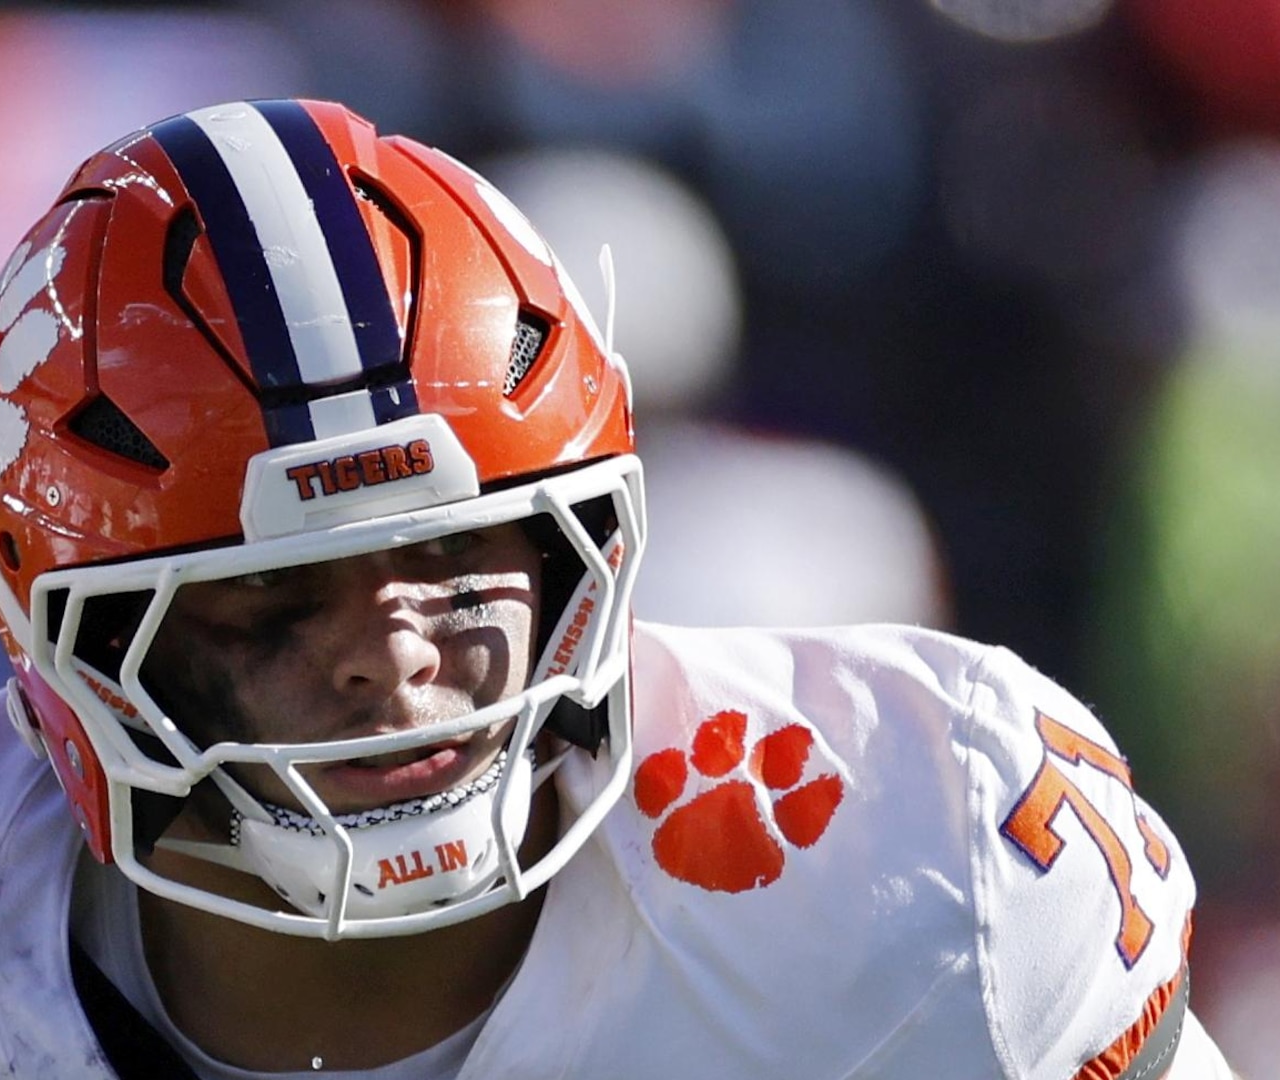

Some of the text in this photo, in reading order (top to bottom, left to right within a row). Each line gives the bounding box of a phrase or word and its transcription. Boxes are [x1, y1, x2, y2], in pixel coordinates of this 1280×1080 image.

[286, 438, 435, 501] TIGERS
[377, 839, 468, 889] ALL IN
